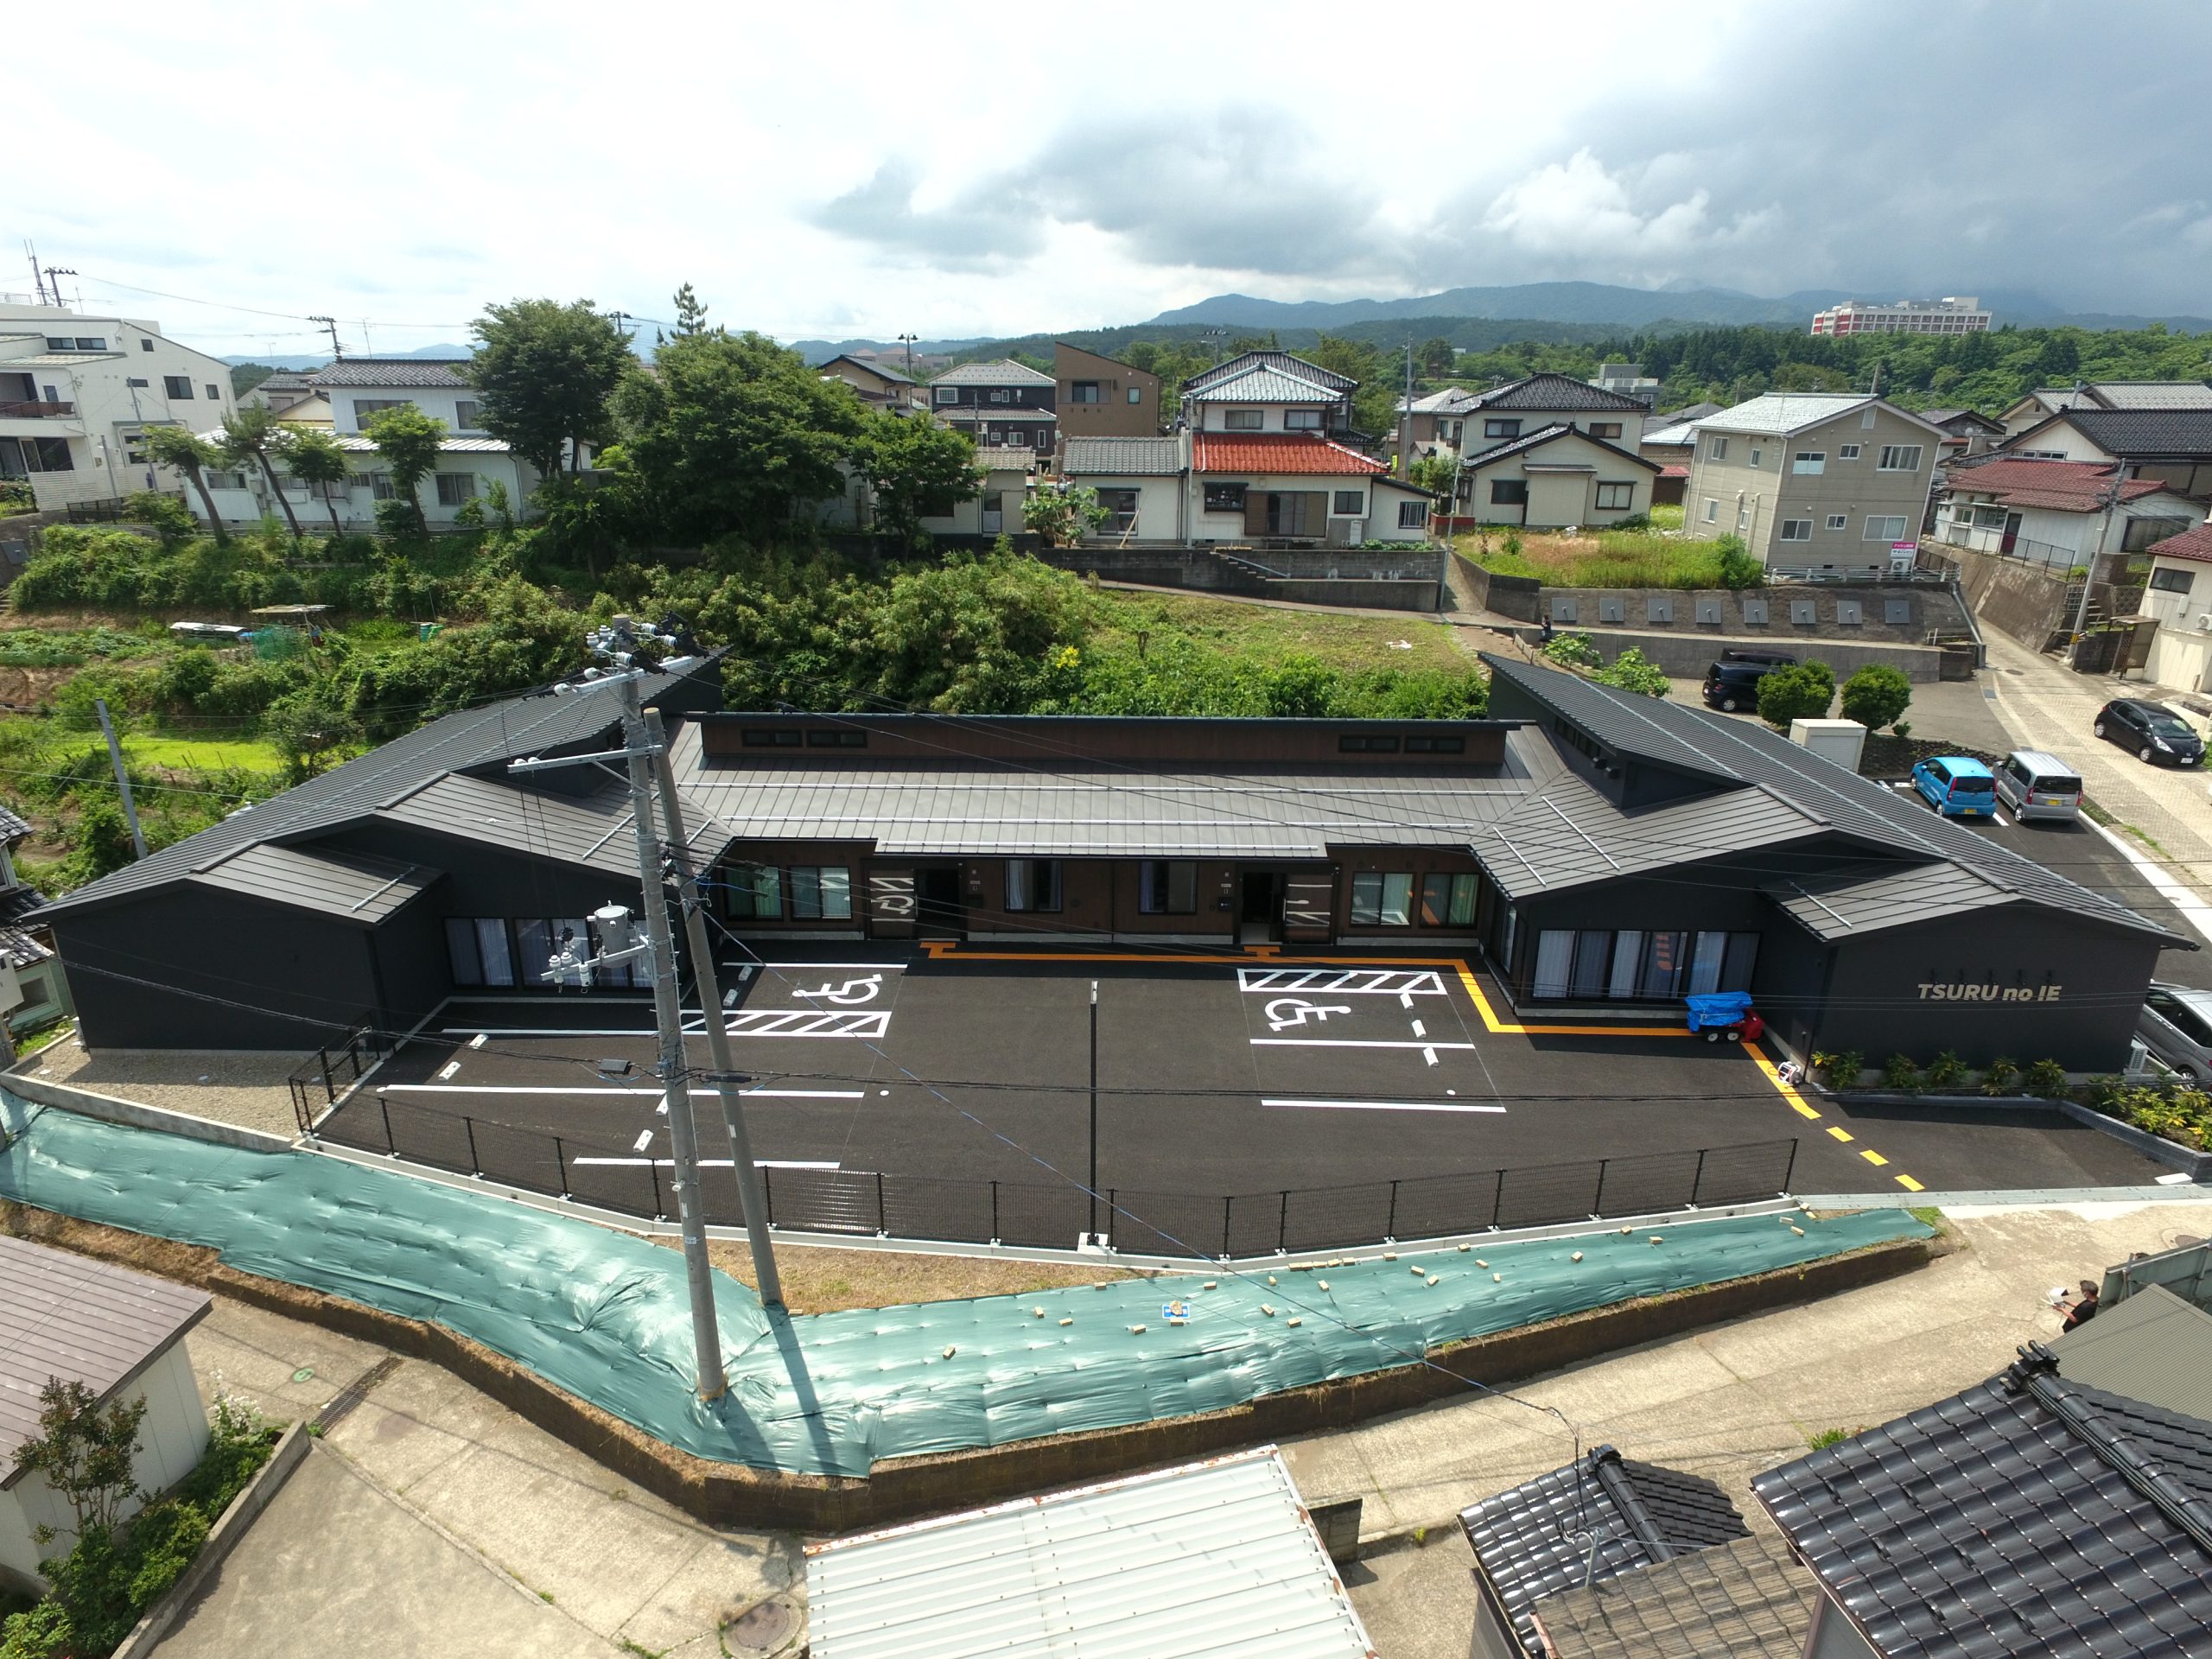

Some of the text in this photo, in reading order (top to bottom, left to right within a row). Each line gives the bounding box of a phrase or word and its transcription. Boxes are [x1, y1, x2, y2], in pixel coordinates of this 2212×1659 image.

[1917, 983, 2063, 1001] TSURU no IE
